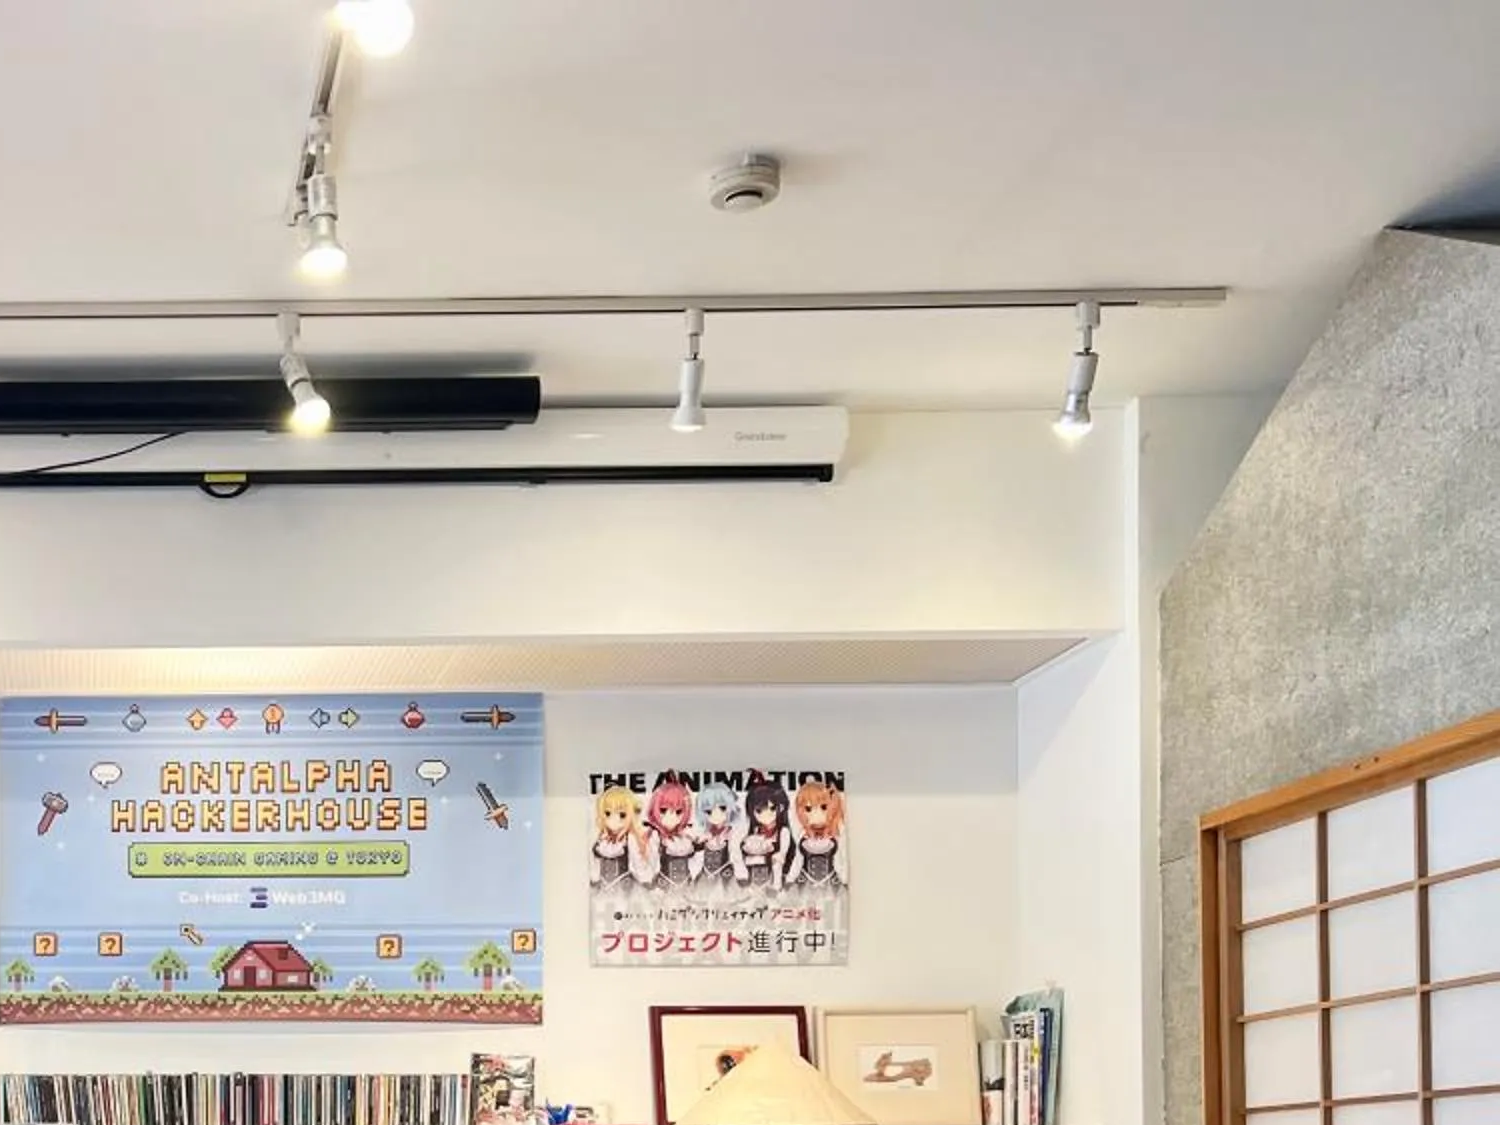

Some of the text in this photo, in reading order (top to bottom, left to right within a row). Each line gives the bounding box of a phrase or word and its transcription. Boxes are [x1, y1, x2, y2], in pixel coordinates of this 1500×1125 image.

[161, 760, 392, 793] ANTALPHA
[589, 773, 646, 794] THE
[111, 798, 427, 832] HACKERHOUSE
[346, 850, 402, 866] TOKYO
